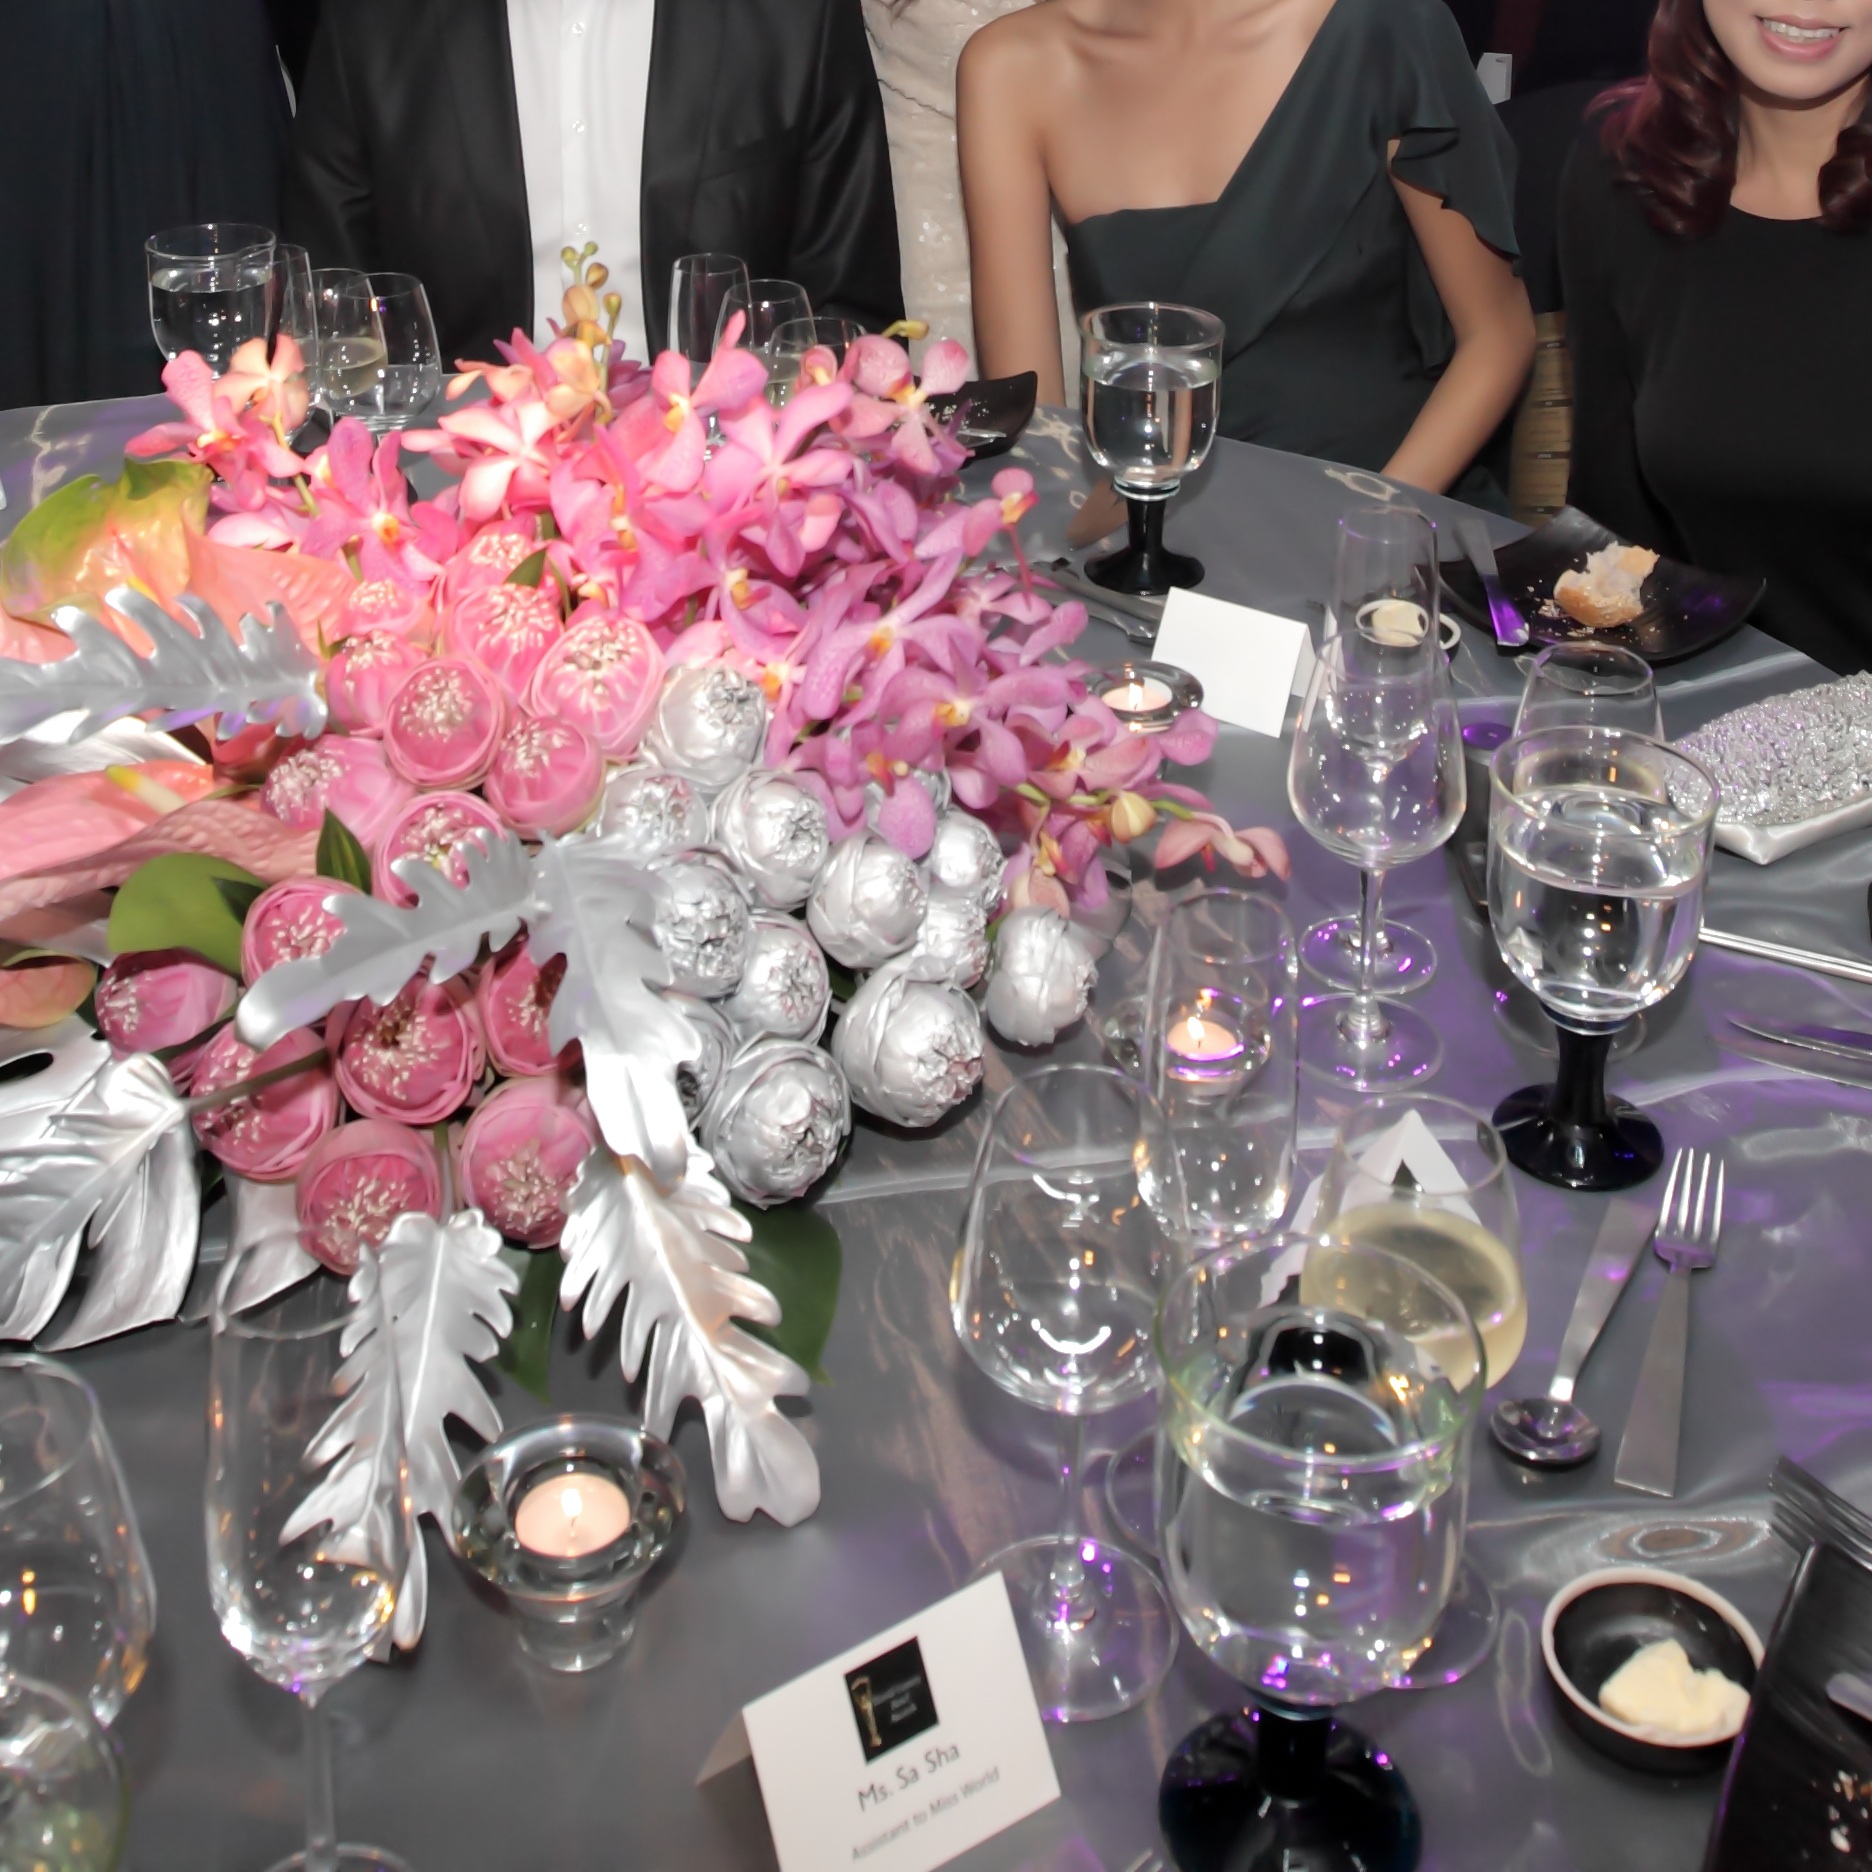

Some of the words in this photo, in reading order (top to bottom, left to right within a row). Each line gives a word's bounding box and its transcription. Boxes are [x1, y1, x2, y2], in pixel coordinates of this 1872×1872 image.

[851, 1819, 911, 1863] Assistant
[929, 1792, 960, 1816] Miss
[960, 1765, 1001, 1799] World
[857, 1783, 894, 1813] Ms.
[895, 1765, 920, 1790] Sa
[924, 1743, 960, 1774] Sha
